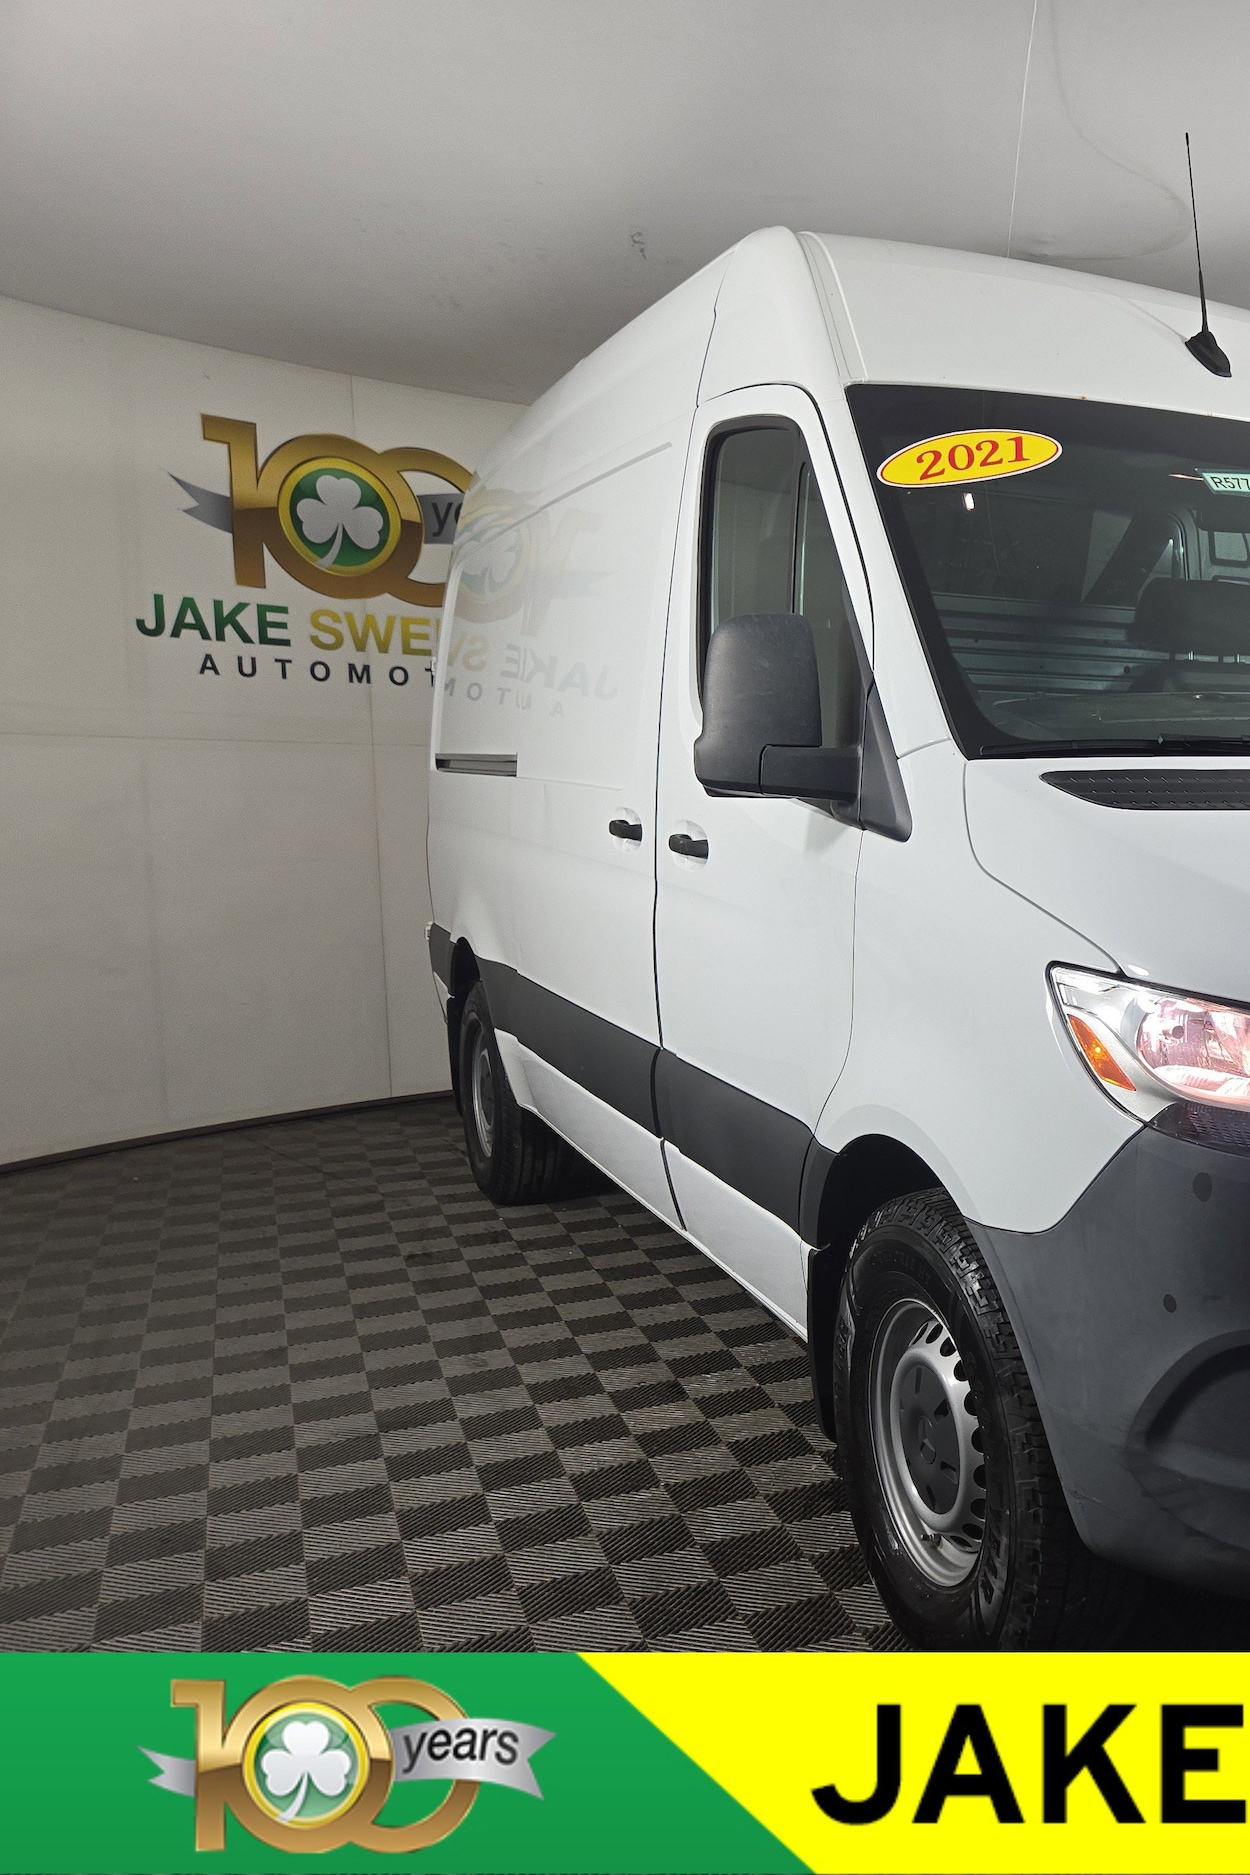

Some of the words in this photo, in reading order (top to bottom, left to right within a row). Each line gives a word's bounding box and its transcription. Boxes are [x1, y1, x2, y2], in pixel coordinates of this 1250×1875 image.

[917, 436, 1031, 481] 2021
[136, 594, 292, 647] JAKE
[309, 608, 441, 656] SWE
